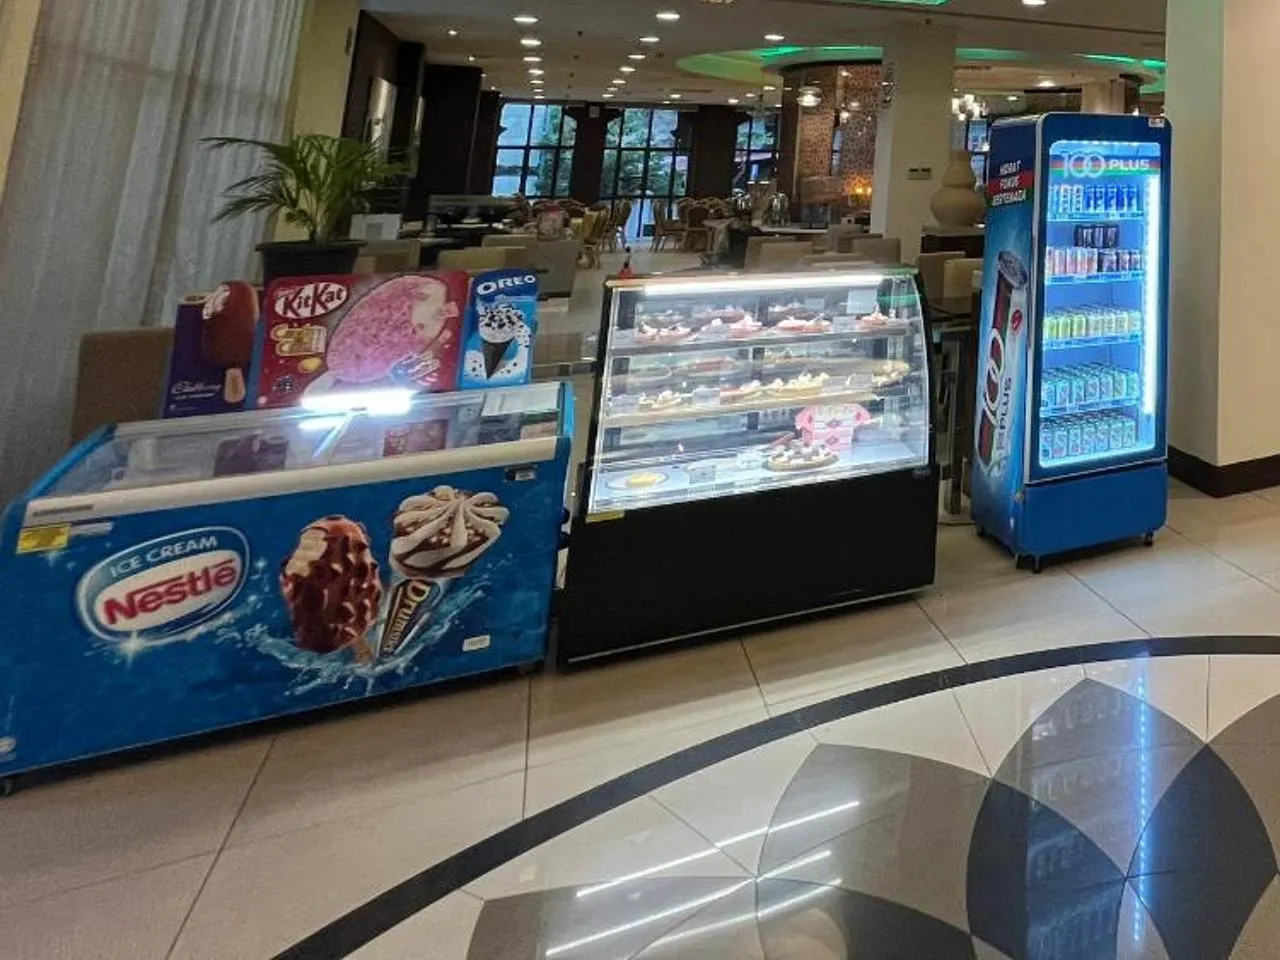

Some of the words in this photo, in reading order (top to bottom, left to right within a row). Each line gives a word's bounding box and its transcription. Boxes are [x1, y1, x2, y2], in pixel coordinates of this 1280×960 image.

[1060, 151, 1106, 179] 100
[1108, 158, 1150, 171] PLUS
[282, 283, 345, 317] KitKat
[477, 274, 536, 295] OREO
[110, 555, 143, 578] ICE
[145, 536, 219, 563] CREAM
